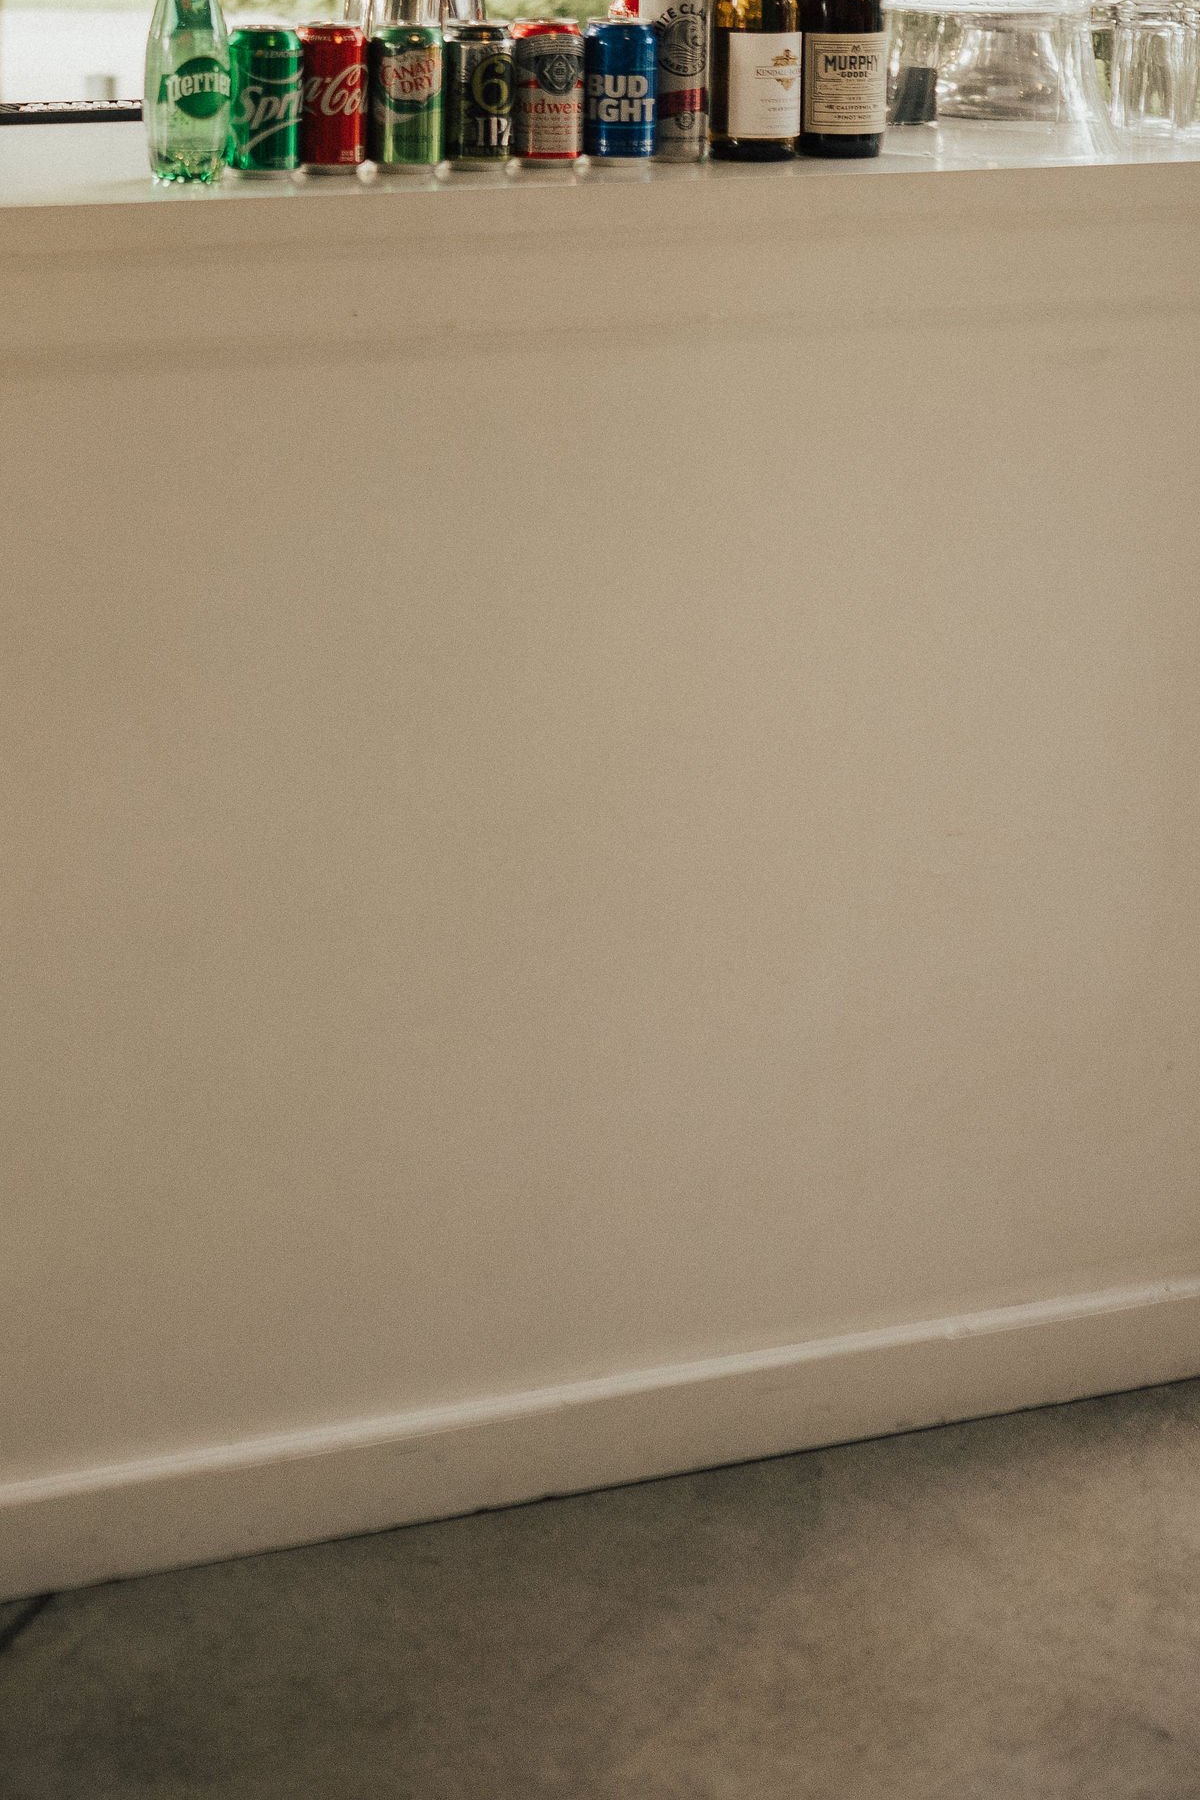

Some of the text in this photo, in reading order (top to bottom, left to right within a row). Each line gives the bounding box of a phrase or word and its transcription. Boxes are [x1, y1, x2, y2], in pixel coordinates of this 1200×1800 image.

[680, 3, 706, 21] CLA
[382, 59, 436, 87] CANAD
[824, 55, 879, 73] MURPHY
[588, 74, 648, 98] BUD
[233, 80, 304, 130] Spri
[517, 100, 583, 114] udweis
[585, 98, 655, 122] IGHT
